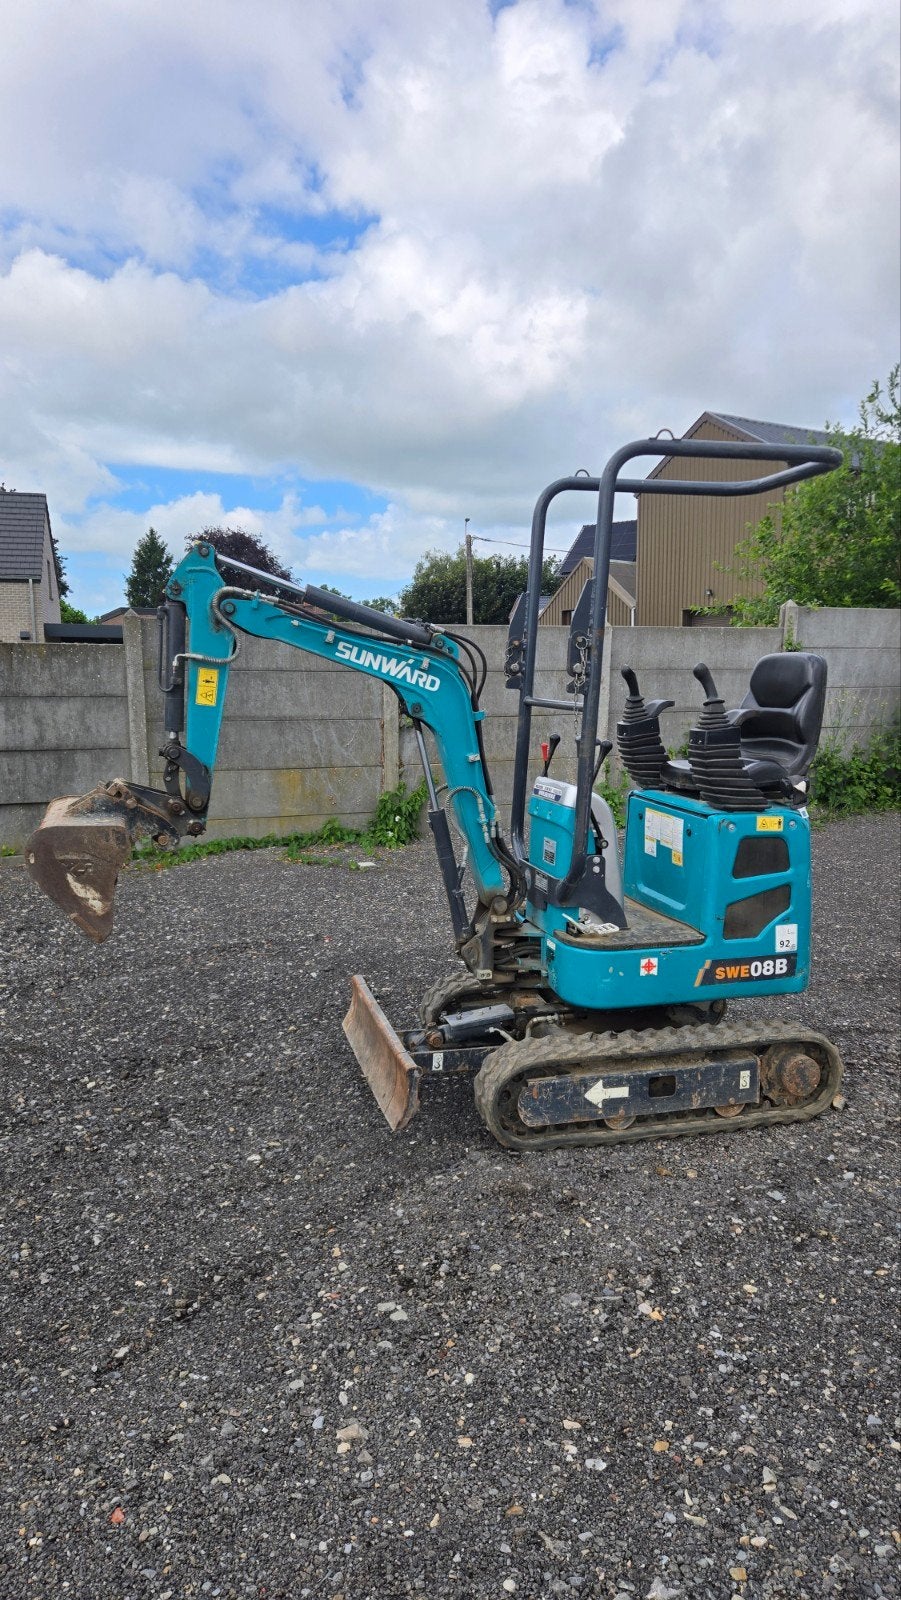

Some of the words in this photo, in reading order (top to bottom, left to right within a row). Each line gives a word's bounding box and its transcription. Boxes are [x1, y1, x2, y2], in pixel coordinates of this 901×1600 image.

[335, 641, 441, 692] SUNWARD
[779, 939, 791, 948] 92
[715, 958, 788, 980] SWE08B
